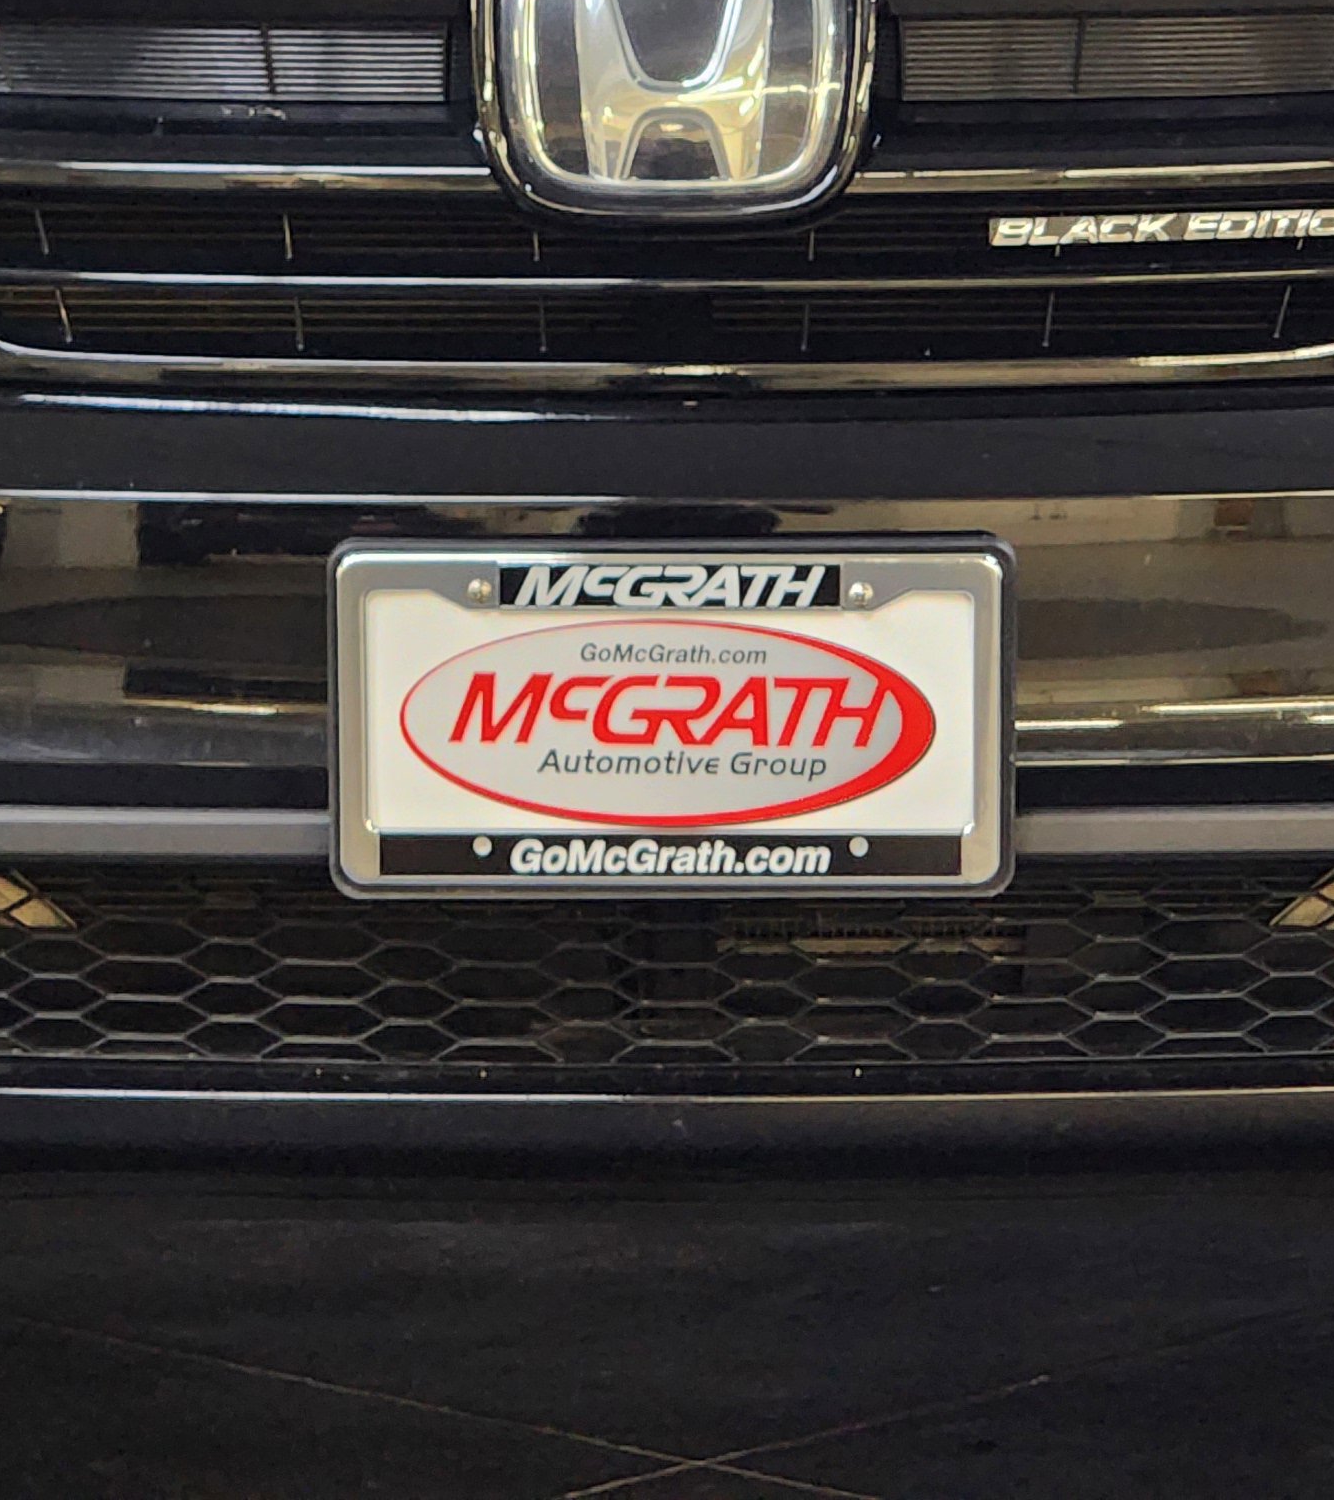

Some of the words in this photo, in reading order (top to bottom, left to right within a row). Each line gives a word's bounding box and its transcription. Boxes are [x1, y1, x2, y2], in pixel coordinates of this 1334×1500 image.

[990, 214, 1177, 247] BLACK
[580, 642, 767, 665] GoMcGrath.com
[536, 748, 721, 775] Automotive
[729, 751, 827, 783] Group
[510, 838, 831, 874] GoMcGrath.com
